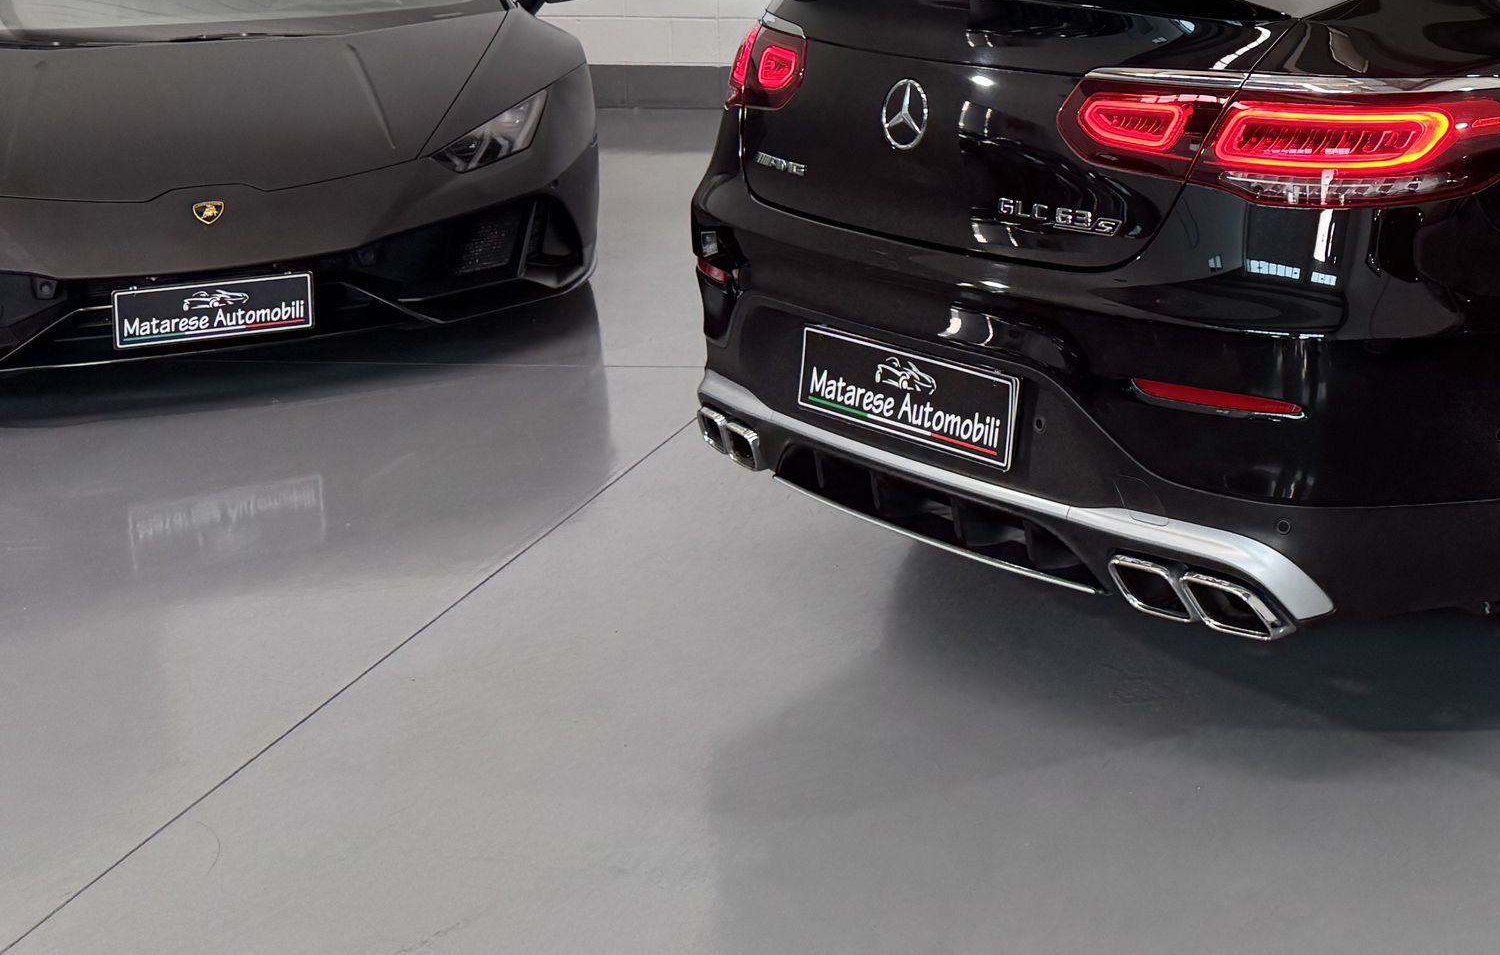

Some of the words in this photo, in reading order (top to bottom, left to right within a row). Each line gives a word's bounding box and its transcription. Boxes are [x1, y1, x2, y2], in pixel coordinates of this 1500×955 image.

[998, 197, 1048, 220] GLC
[123, 314, 210, 338] Matarese
[213, 300, 305, 328] Automobili
[809, 366, 895, 418] Matarese
[897, 393, 1001, 449] Automobili
